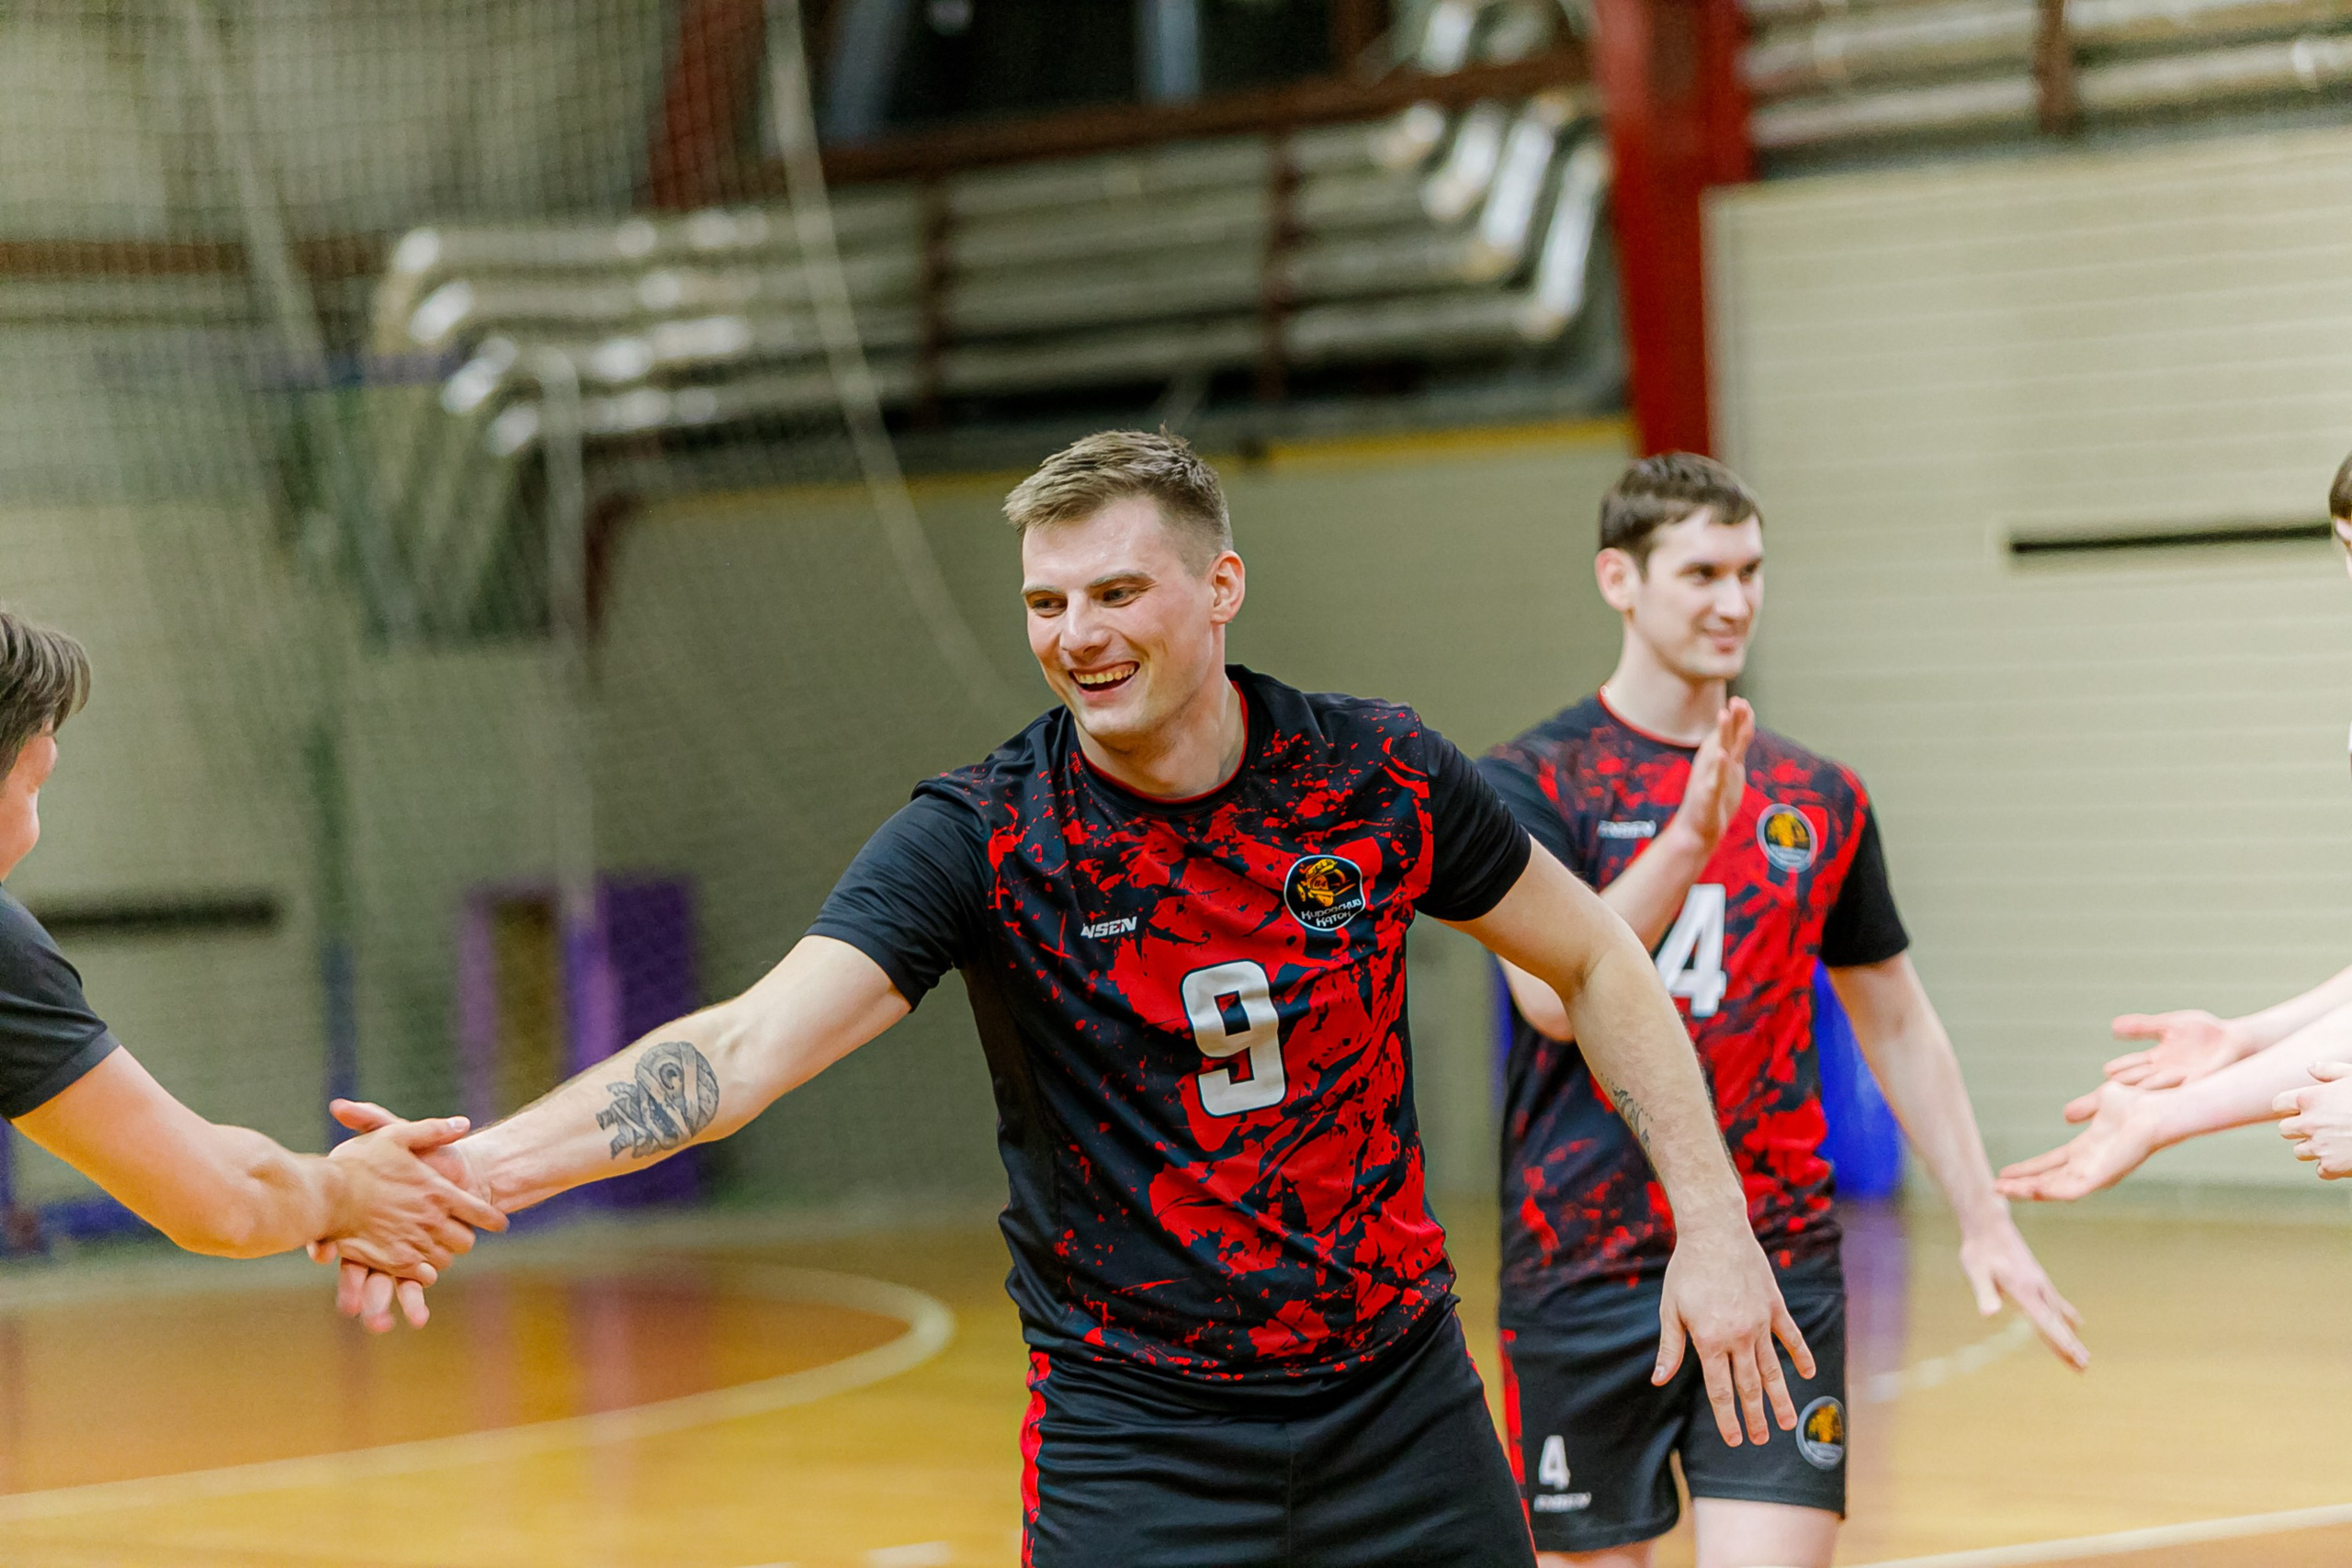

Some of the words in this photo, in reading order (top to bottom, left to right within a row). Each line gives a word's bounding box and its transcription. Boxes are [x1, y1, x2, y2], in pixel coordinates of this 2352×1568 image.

[1080, 916, 1137, 939] NSEN
[1654, 883, 1727, 1017] 4
[1182, 960, 1286, 1116] 9
[1538, 1434, 1571, 1490] 4
